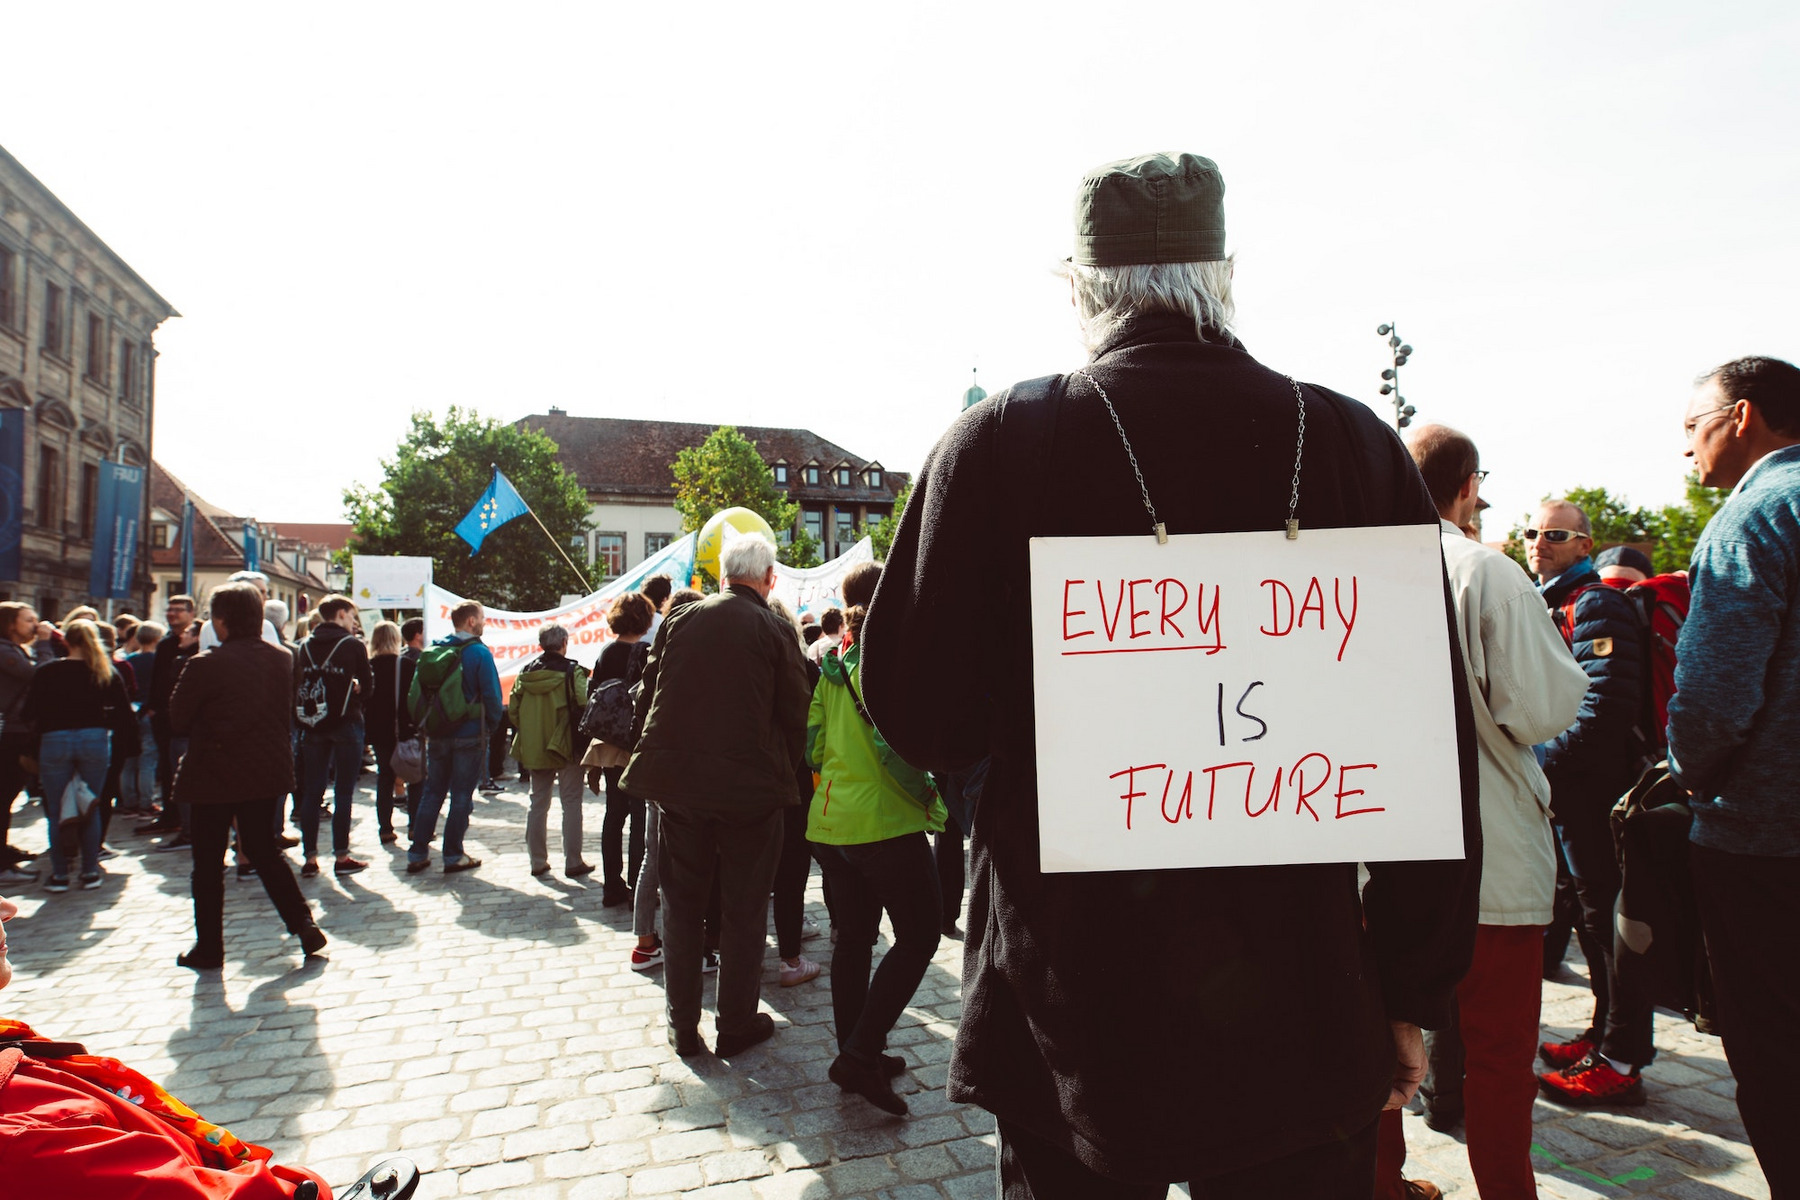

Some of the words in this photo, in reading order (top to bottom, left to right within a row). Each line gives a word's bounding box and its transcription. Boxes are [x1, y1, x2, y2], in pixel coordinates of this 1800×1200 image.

[113, 466, 139, 483] FAU
[1063, 578, 1221, 655] EVERY
[1260, 576, 1358, 661] DAY
[1218, 681, 1268, 746] IS
[1109, 752, 1386, 830] FUTURE
